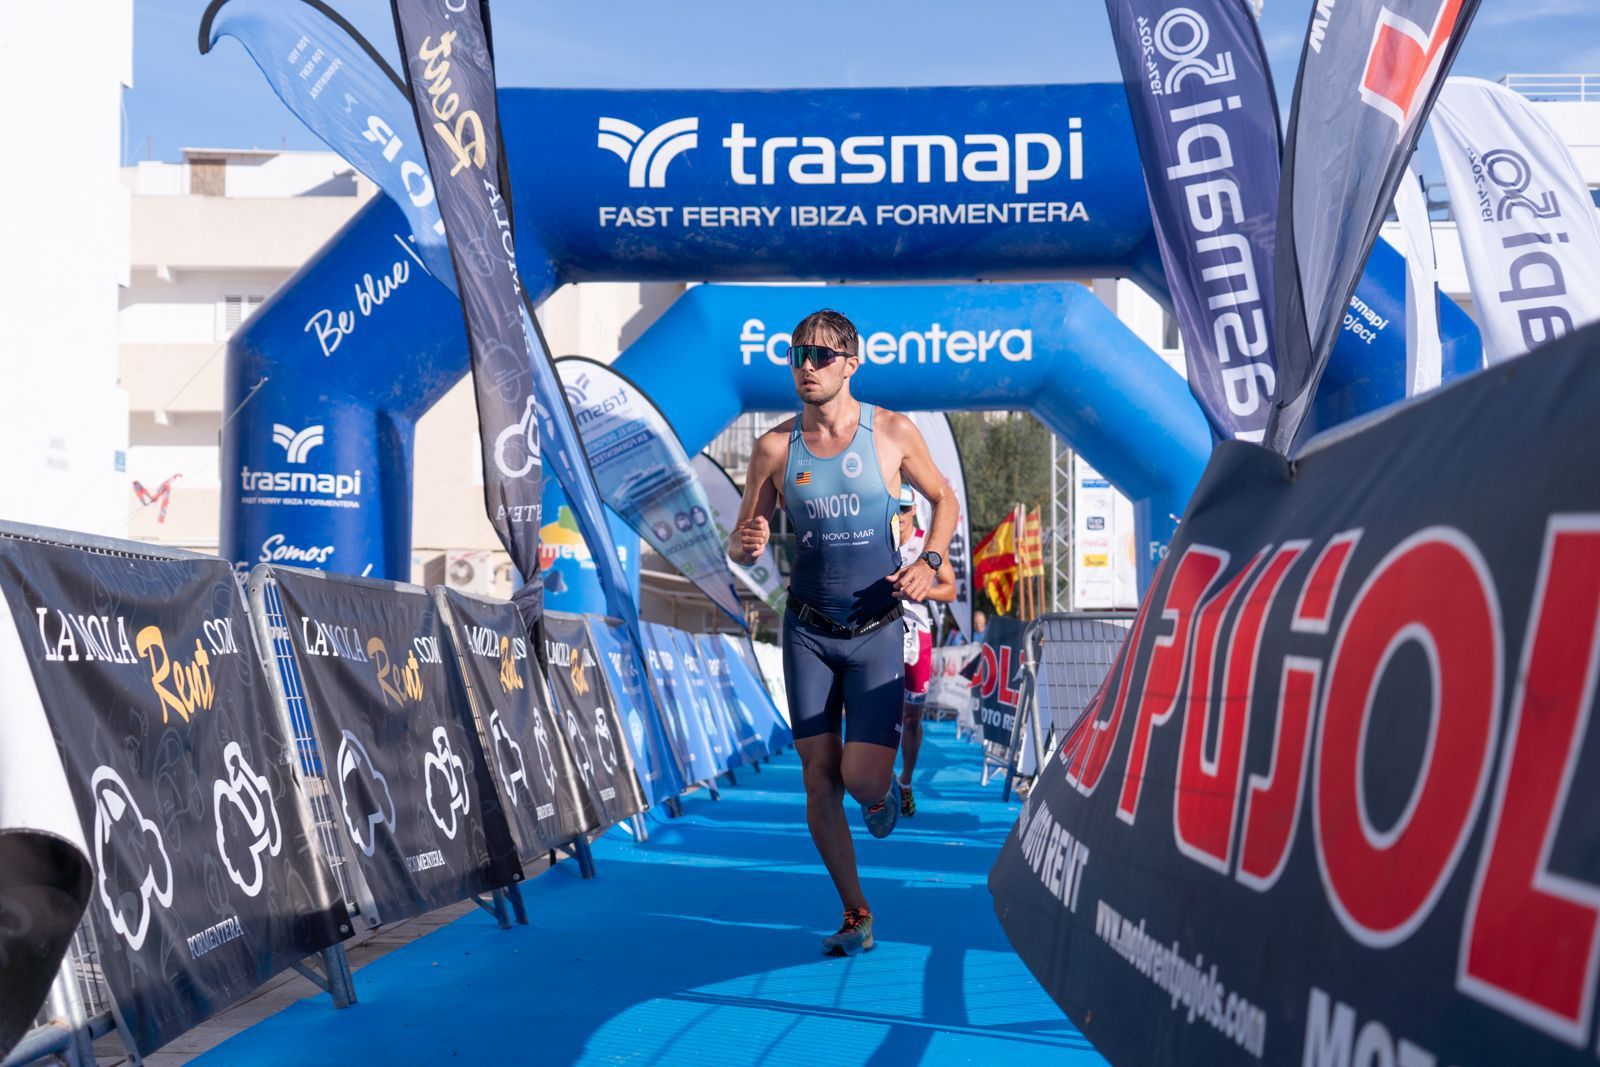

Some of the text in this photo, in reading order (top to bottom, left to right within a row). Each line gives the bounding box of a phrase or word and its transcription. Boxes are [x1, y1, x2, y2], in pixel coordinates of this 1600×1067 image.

[722, 117, 1084, 194] trasmapi
[599, 201, 1090, 228] FAST FERRY IBIZA FORMENTERA
[1343, 313, 1377, 345] oject
[1350, 295, 1390, 331] smapi
[304, 308, 355, 357] Be
[740, 318, 1033, 366] foentera
[241, 466, 361, 498] trasmapi
[258, 497, 282, 505] FERRY
[282, 498, 303, 506] IBIZA
[304, 499, 360, 509] FORMENTERA
[804, 493, 860, 520] DINOTO
[258, 533, 335, 563] Somos
[822, 528, 875, 541] NOVO MAR
[136, 625, 215, 724] Rent
[367, 636, 424, 708] Rent
[1041, 821, 1090, 914] RENT
[186, 915, 244, 960] FORMENTERA
